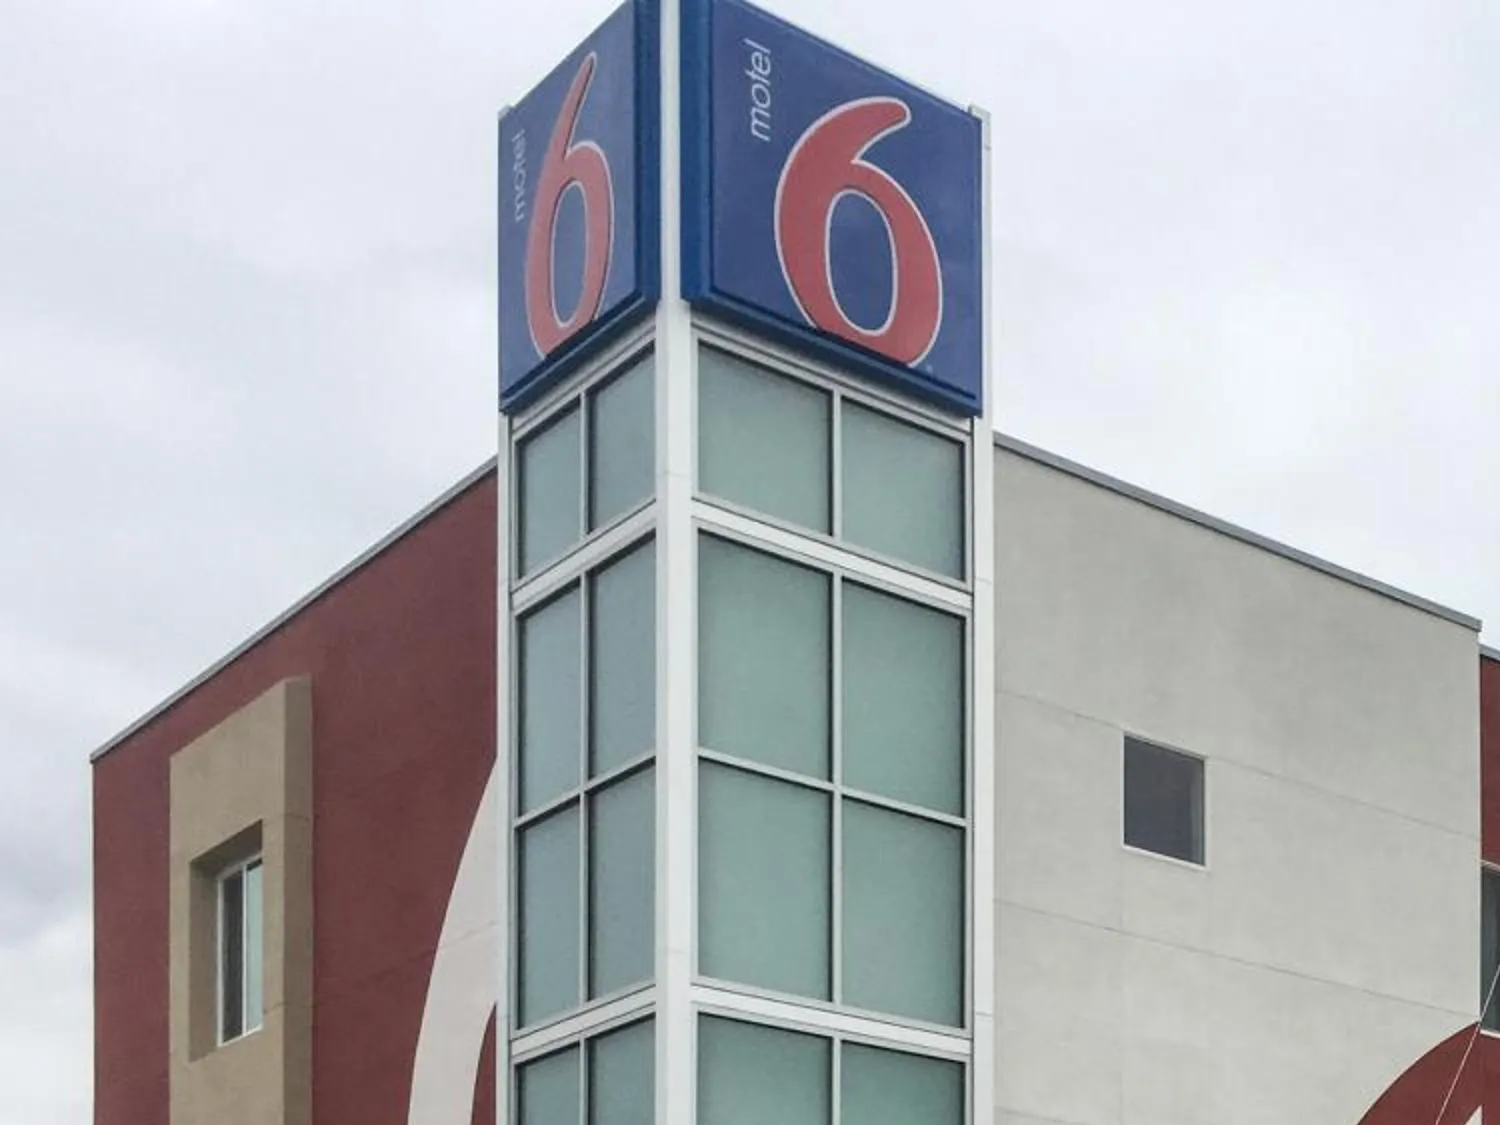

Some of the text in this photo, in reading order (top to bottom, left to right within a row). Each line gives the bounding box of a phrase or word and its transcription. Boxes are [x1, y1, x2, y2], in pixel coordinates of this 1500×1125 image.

[524, 50, 615, 360] 6
[743, 38, 943, 368] motel 6
